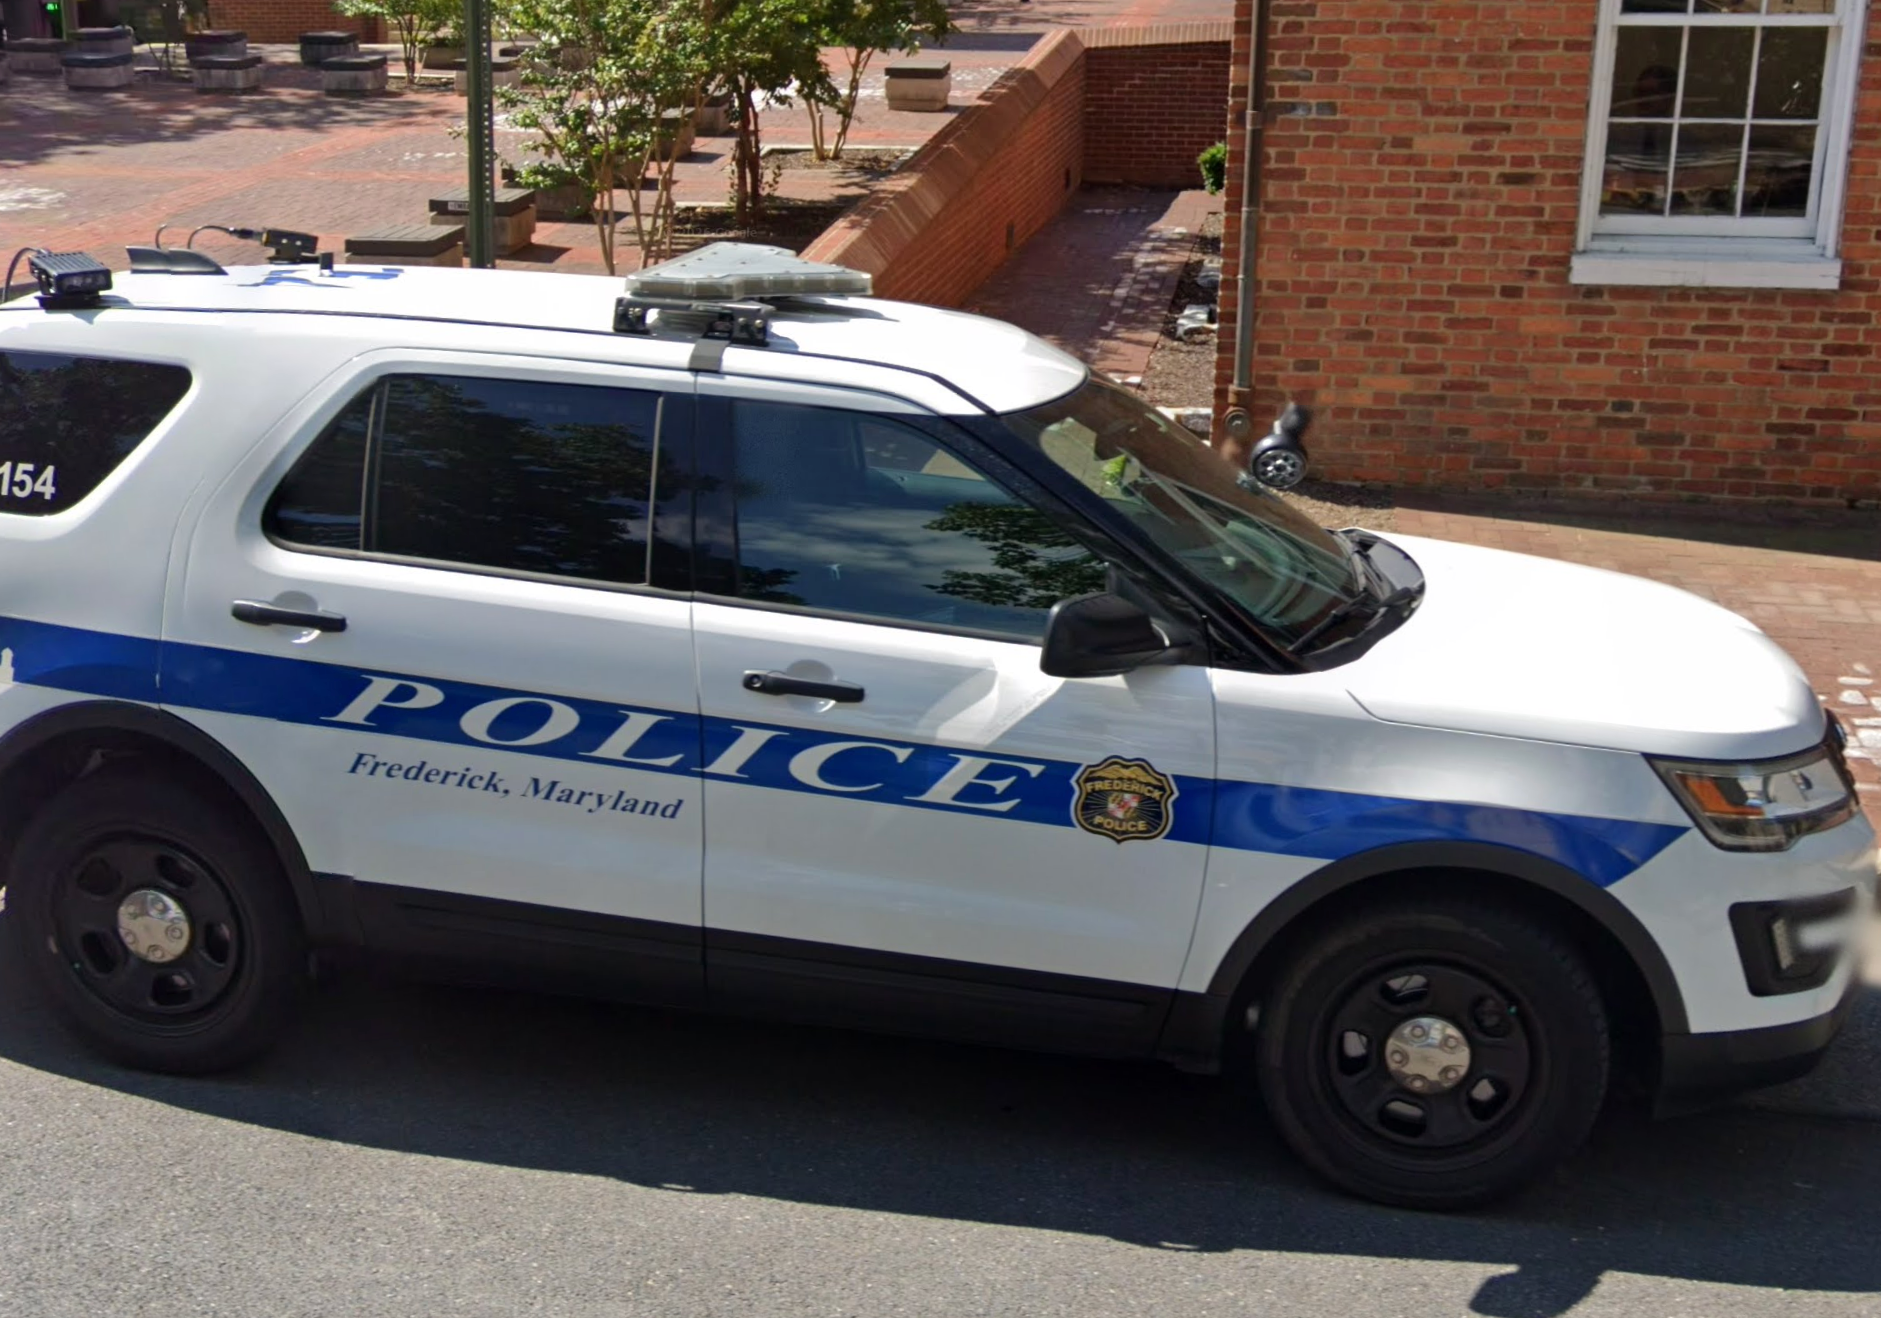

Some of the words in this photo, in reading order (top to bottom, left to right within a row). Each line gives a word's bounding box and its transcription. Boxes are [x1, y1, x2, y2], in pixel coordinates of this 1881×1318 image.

[0, 461, 56, 500] 154
[319, 674, 1046, 812] POLICE
[346, 752, 510, 798] Frederick,
[520, 776, 684, 820] Maryland
[1085, 780, 1163, 800] FREDERICK
[1093, 815, 1147, 831] POLICE
